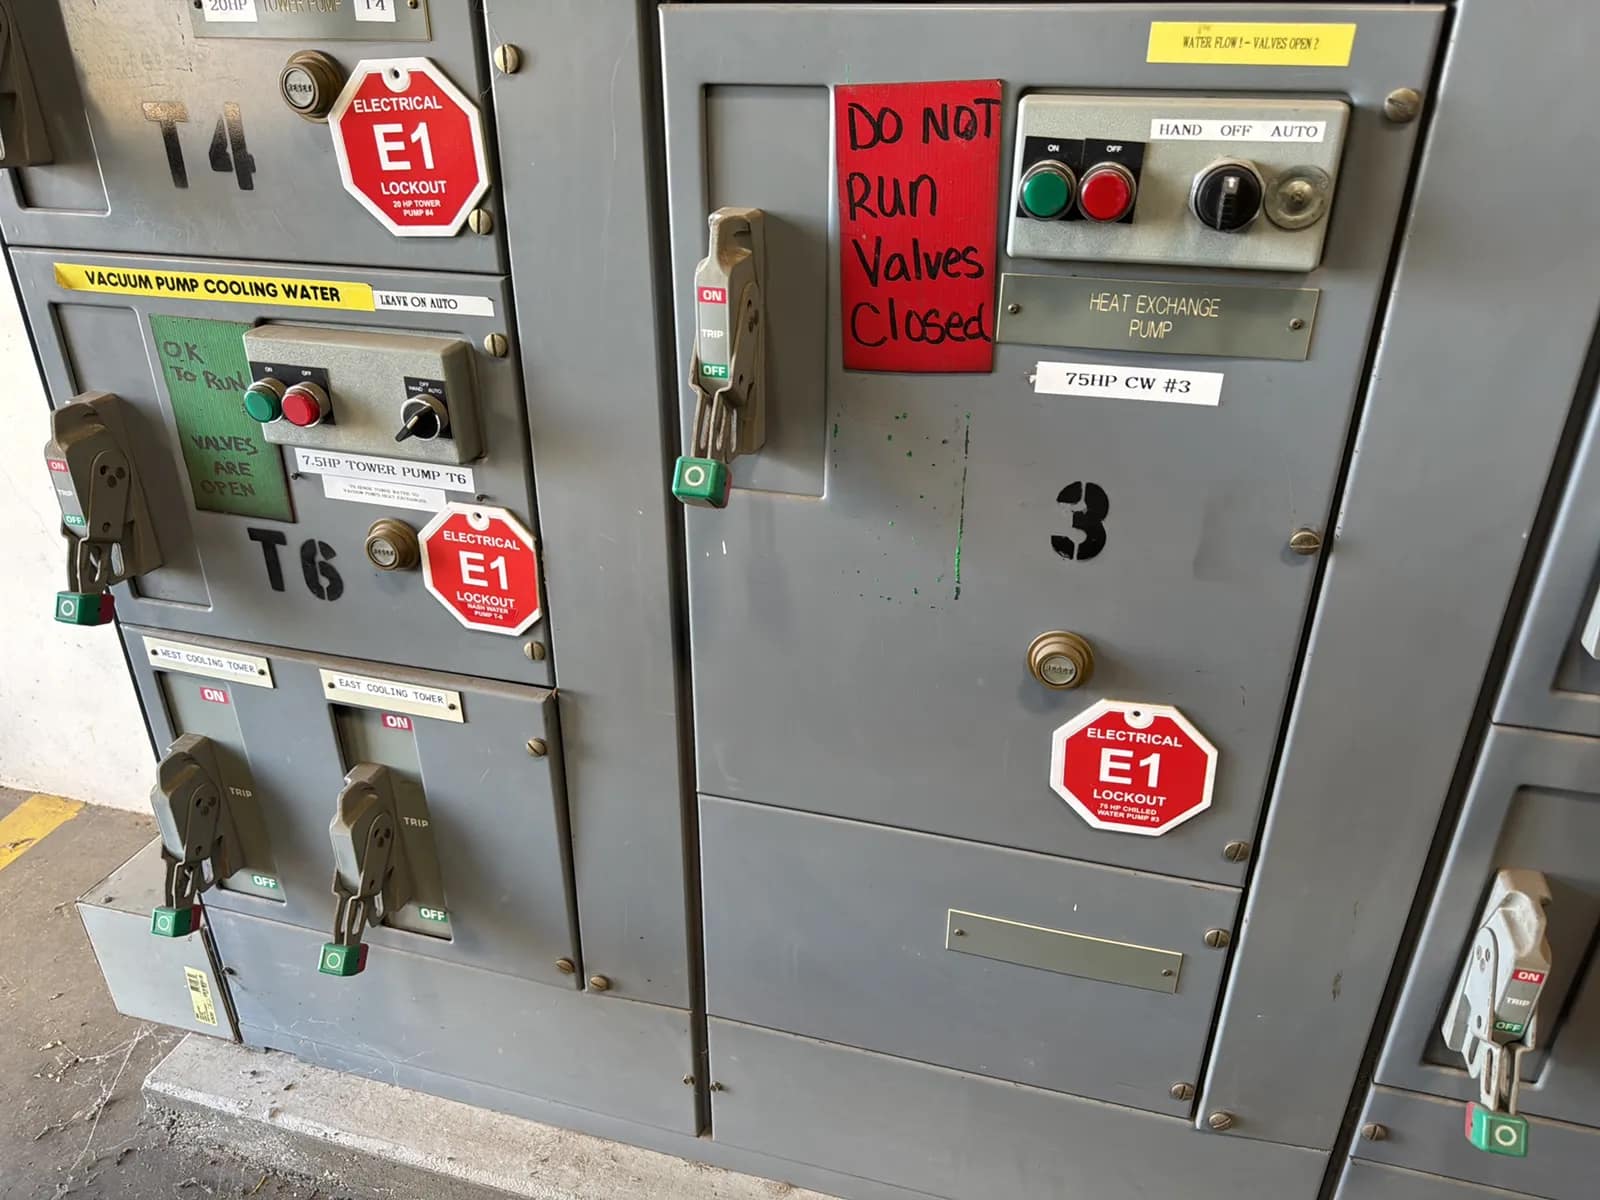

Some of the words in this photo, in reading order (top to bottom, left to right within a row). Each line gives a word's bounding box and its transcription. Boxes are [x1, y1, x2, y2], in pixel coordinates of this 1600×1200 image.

[263, 0, 303, 14] TOWER
[306, 0, 343, 13] PUMP
[1183, 36, 1212, 49] WATER
[1253, 37, 1290, 50] VALVES
[353, 96, 442, 112] ELECTRICAL
[848, 102, 903, 151] DO
[922, 97, 1000, 144] NOT
[1159, 124, 1202, 136] HAND
[1220, 125, 1252, 137] OFF
[1270, 126, 1318, 138] AUTO
[373, 122, 434, 171] E1
[1047, 144, 1060, 152] ON
[381, 180, 447, 195] LOCKOUT
[403, 200, 413, 208] HP
[414, 200, 441, 208] TOWER
[846, 172, 937, 221] Run
[403, 209, 424, 217] PUMP
[852, 236, 985, 287] Valves
[84, 271, 153, 290] VACUUM
[155, 276, 199, 293] PUMP
[204, 279, 278, 298] COOLING
[282, 284, 341, 302] WATER
[380, 295, 409, 307] LEAVE
[410, 297, 427, 308] ON
[430, 298, 458, 310] AUTO
[703, 290, 722, 301] ON
[1089, 292, 1131, 313] HEAT
[1135, 295, 1221, 318] EXCHANGE
[851, 298, 991, 347] Closed
[1129, 319, 1173, 339] PUMP
[702, 328, 724, 338] TRIP
[164, 341, 204, 364] OK
[703, 365, 726, 376] OFF
[203, 371, 248, 391] RUN
[1066, 372, 1117, 388] 75HP
[1124, 376, 1156, 390] CW
[1163, 378, 1191, 393] #3
[191, 436, 258, 455] VALVES
[51, 461, 65, 469] ON
[214, 461, 255, 477] ARE
[302, 455, 341, 468] 7.5HP
[345, 460, 397, 476] TOWER
[402, 467, 440, 480] PUMP
[445, 472, 467, 485] T6
[201, 480, 255, 496] OPEN
[66, 515, 82, 524] OFF
[1051, 481, 1109, 560] 3
[443, 530, 521, 550] ELECTRICAL
[247, 527, 344, 601] T6
[459, 550, 509, 591] E1
[456, 591, 516, 608] LOCKOUT
[474, 610, 493, 618] PUMP
[486, 605, 509, 614] WATER
[160, 648, 182, 659] WEST
[186, 653, 224, 668] COOLING
[229, 661, 255, 673] TOWER
[204, 689, 225, 702] ON
[339, 679, 361, 690] EAST
[367, 683, 408, 698] COOLING
[414, 691, 444, 704] TOWER
[386, 715, 409, 729] ON
[1086, 727, 1183, 748] ELECTRICAL
[1099, 747, 1161, 788] E1
[229, 786, 253, 798] TRIP
[1093, 788, 1167, 806] LOCKOUT
[1097, 809, 1125, 818] WATER
[1126, 812, 1149, 822] PUMP
[1122, 805, 1157, 815] CHILLED
[403, 816, 429, 827] TRIP
[253, 875, 276, 888] OFF
[420, 908, 446, 921] OFF
[1518, 971, 1540, 982] ON
[1507, 997, 1530, 1006] TRIP
[1496, 1022, 1521, 1031] OFF
